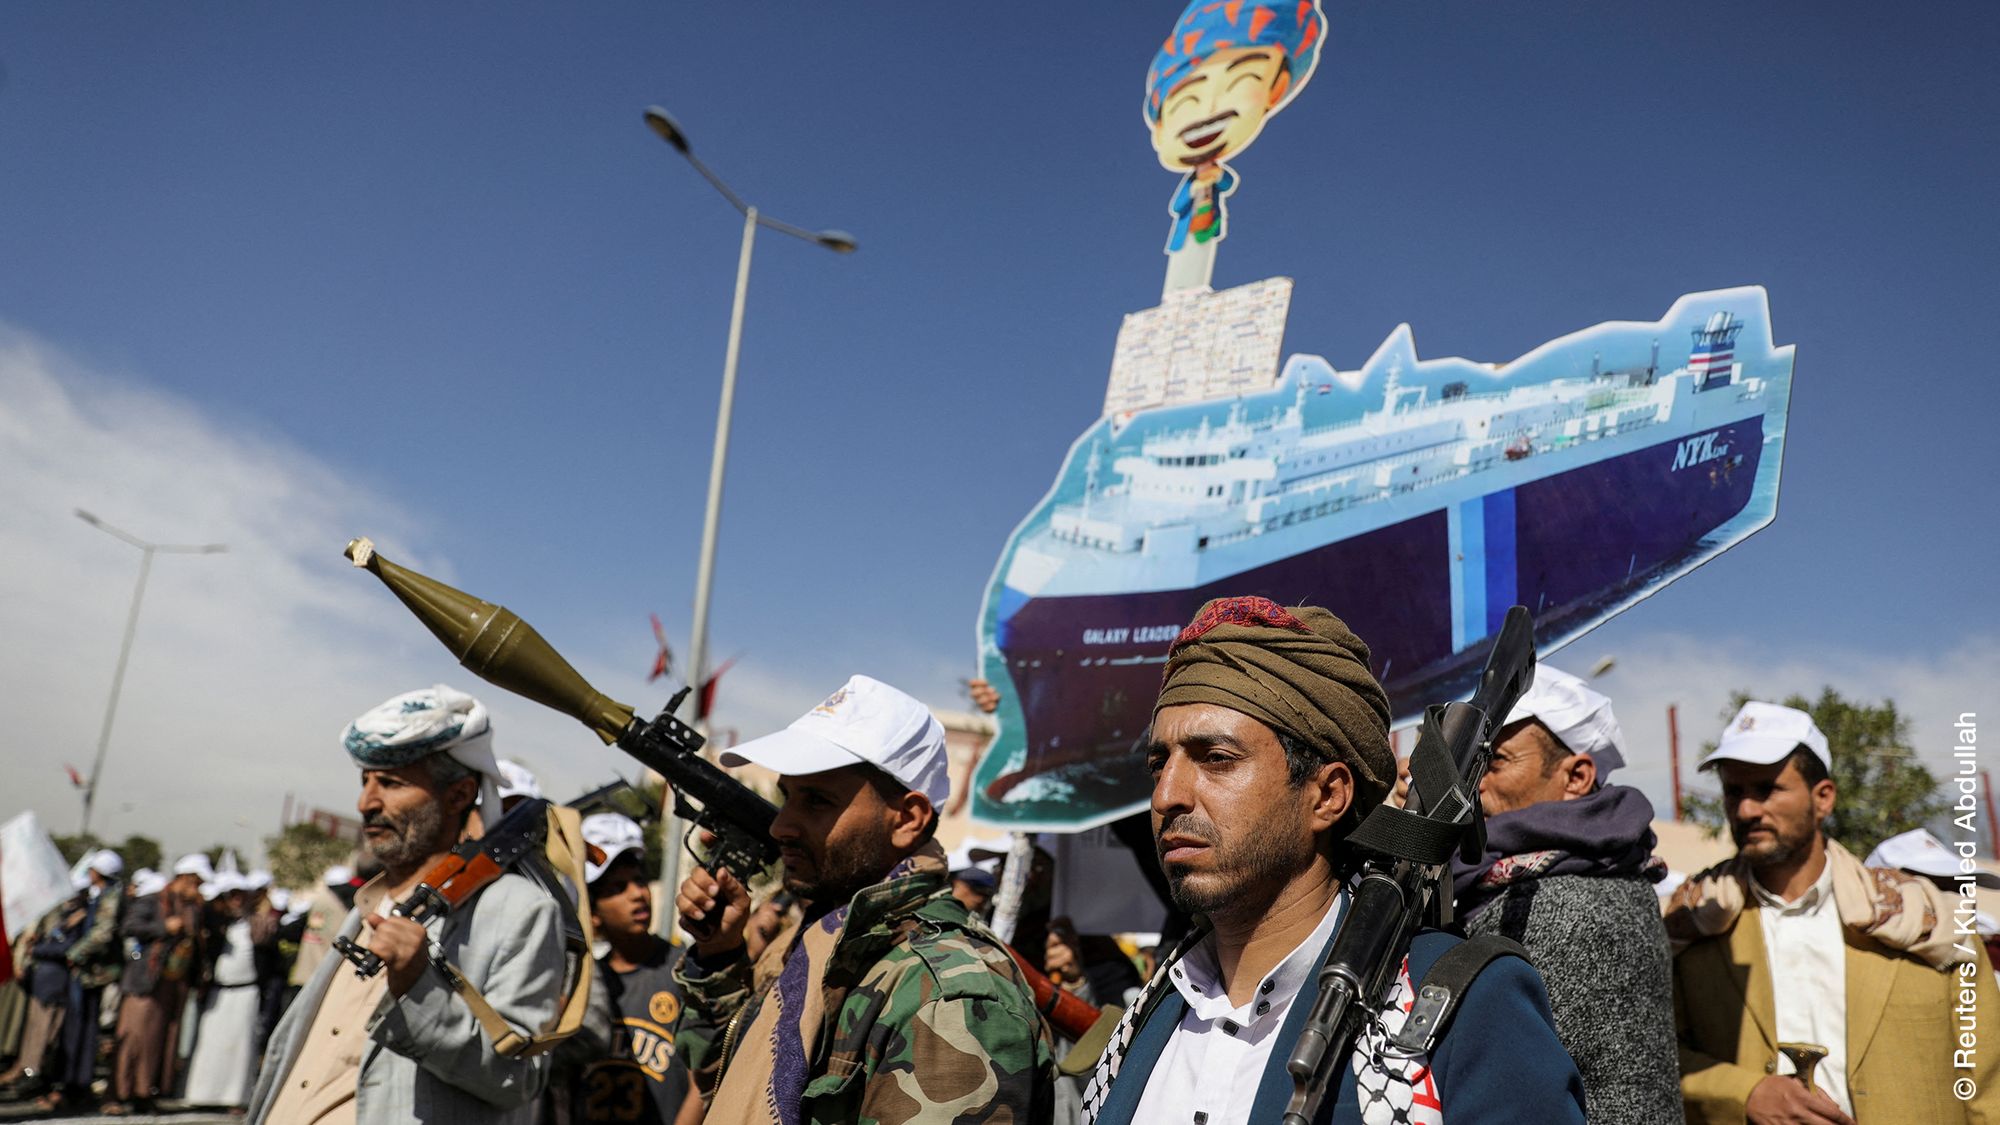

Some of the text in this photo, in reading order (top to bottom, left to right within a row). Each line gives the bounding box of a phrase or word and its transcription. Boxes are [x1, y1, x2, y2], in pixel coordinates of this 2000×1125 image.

[1671, 431, 1719, 472] NYK
[1083, 624, 1181, 645] GALAXY LEADER
[585, 1070, 644, 1121] 23
